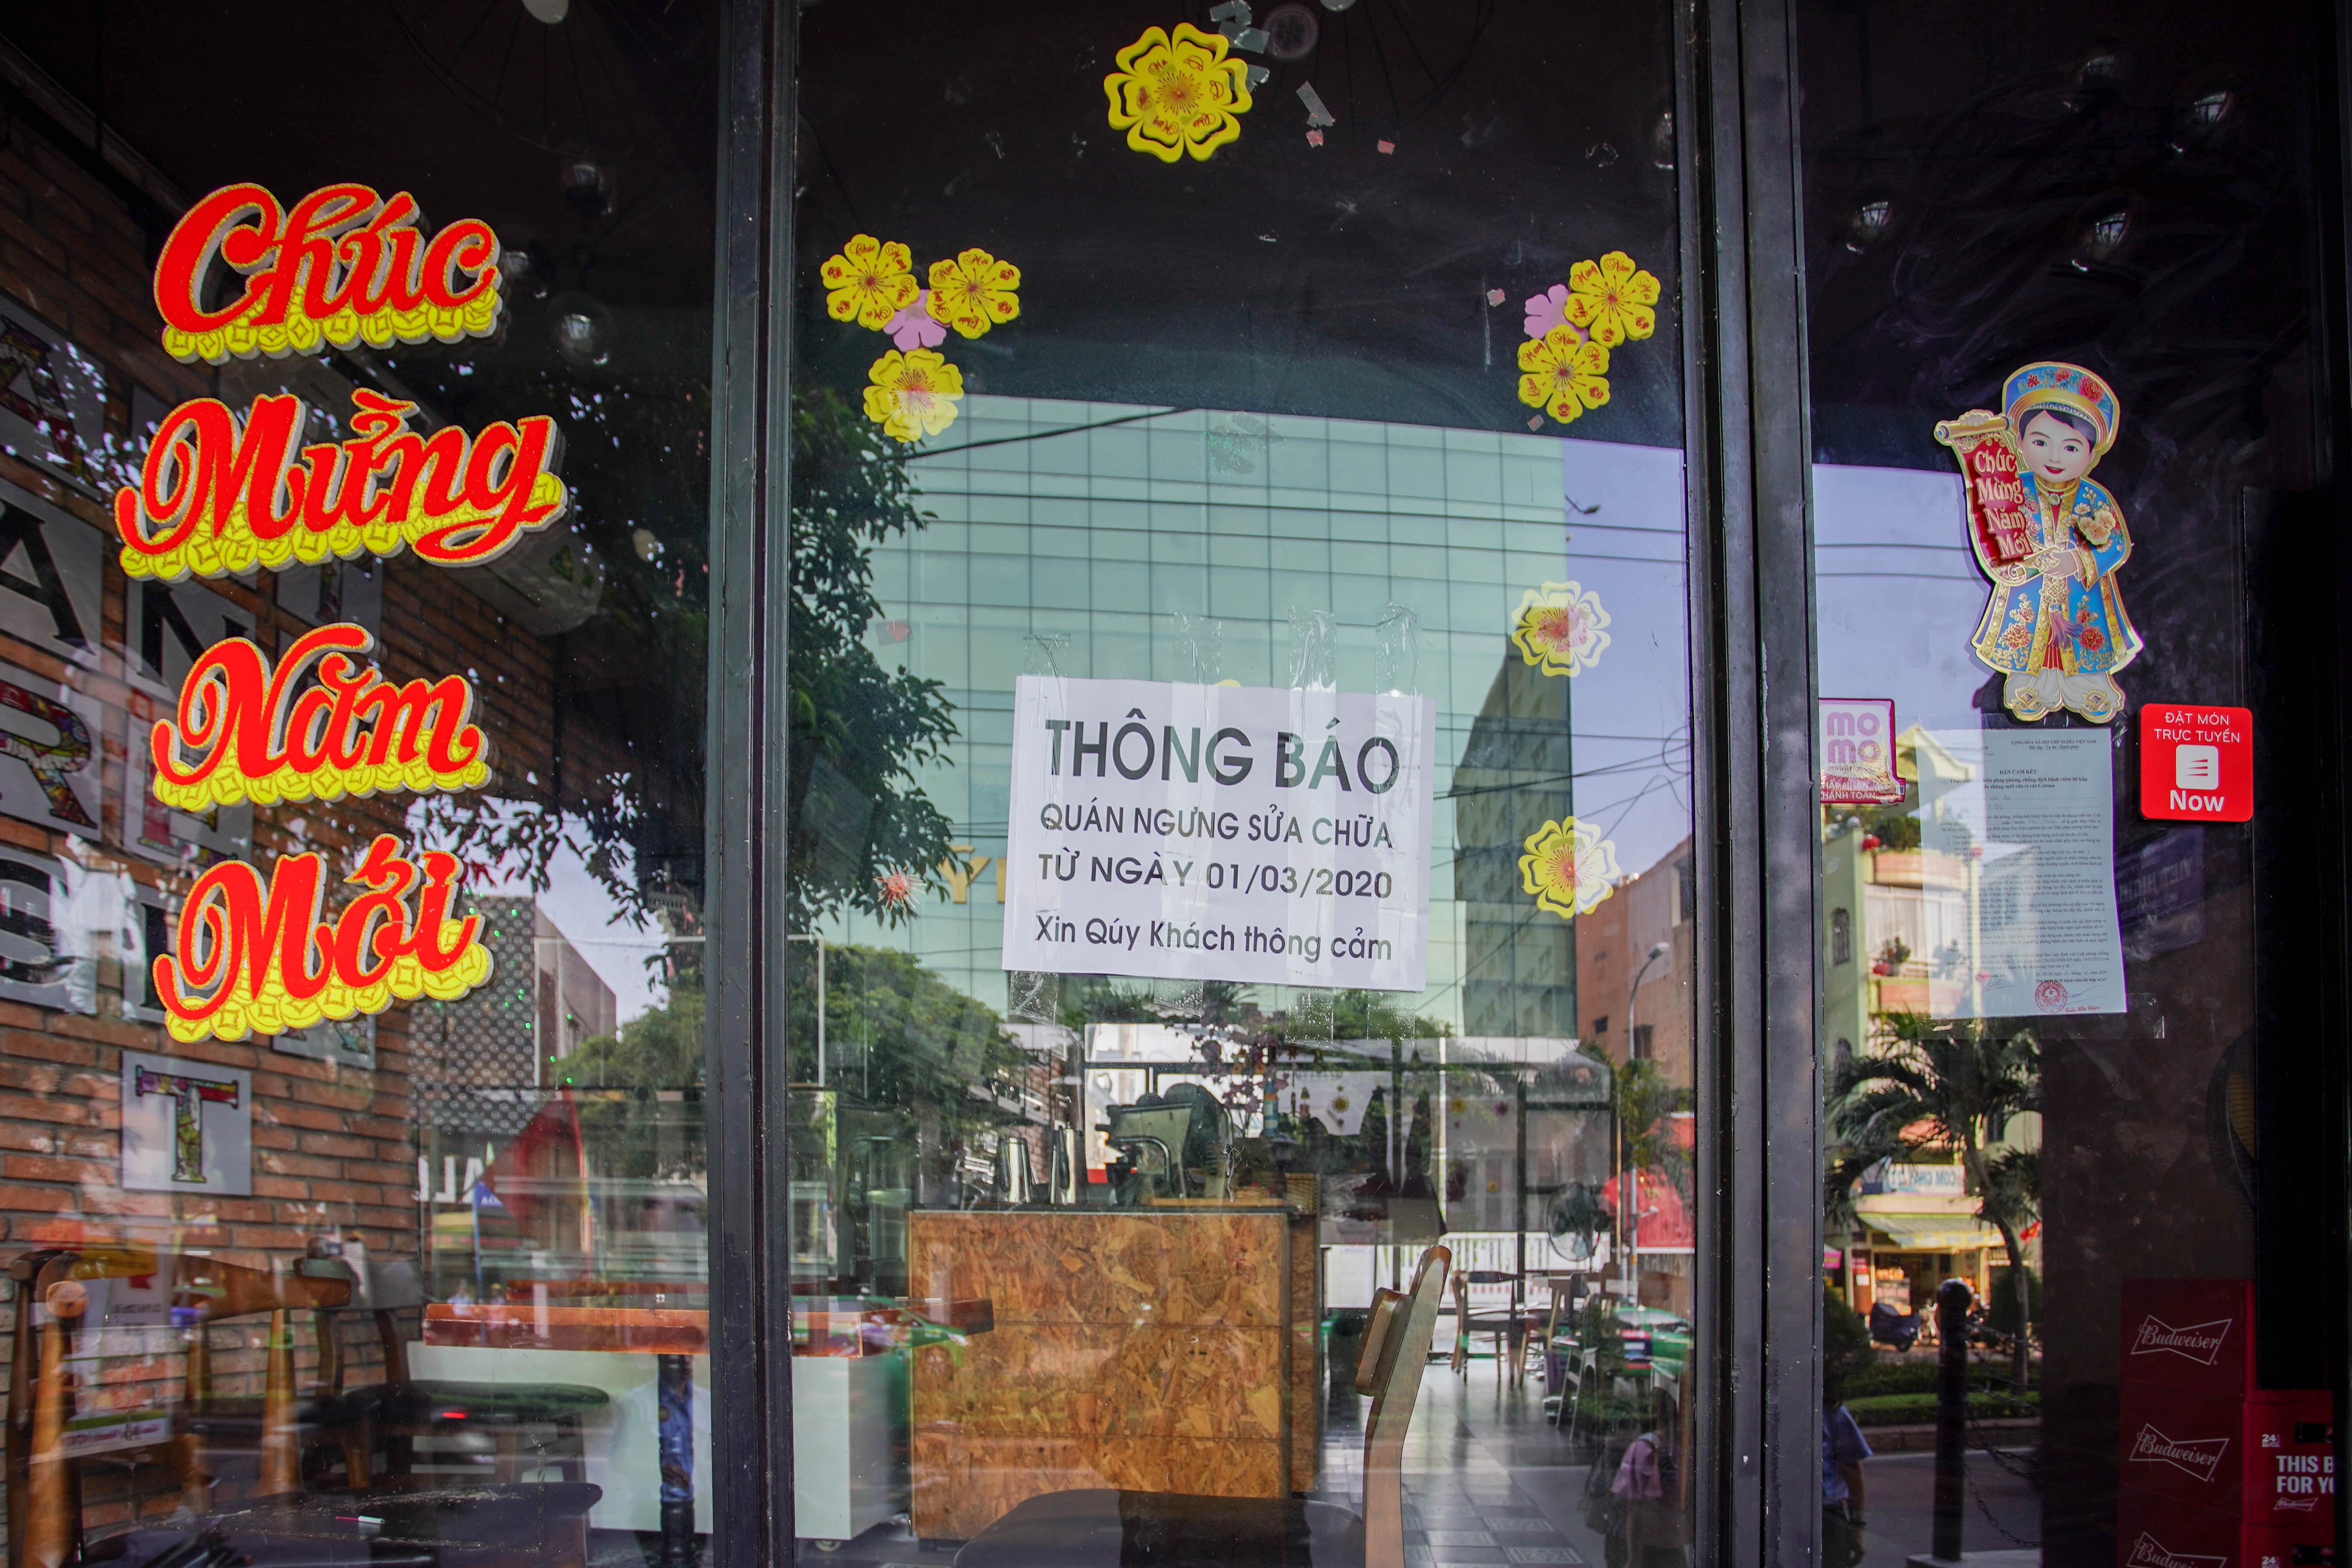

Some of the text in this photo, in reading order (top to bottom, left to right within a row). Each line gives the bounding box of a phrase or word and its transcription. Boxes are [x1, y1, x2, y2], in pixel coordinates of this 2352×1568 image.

[157, 186, 497, 334] Chúc
[116, 388, 557, 561] Mừng
[1974, 448, 2017, 476] Chúc
[1975, 477, 2025, 506] Mừng
[1984, 506, 2026, 533] Năm
[1996, 532, 2034, 560] Mới
[151, 623, 482, 788] Năm
[2165, 710, 2229, 726] ĐẶT MÓN
[2153, 728, 2240, 743] TRỰC TUYẾN
[1045, 707, 1400, 794] THÔNG BÁO
[2170, 789, 2224, 812] Now
[1040, 797, 1393, 849] QUÁN NGƯNG SỬA CHỮA
[1038, 847, 1392, 899] TỪ NGÀY 01/03/2020
[154, 833, 479, 1023] Mới
[1035, 915, 1075, 942] Xin
[1150, 920, 1235, 952] Khách
[1245, 926, 1321, 963] thông
[1331, 927, 1392, 961] cảm
[2138, 1324, 2221, 1350] Budweiser
[2136, 1432, 2216, 1466] Budweiser
[2275, 1455, 2319, 1473] THIS
[2276, 1476, 2314, 1494] FOR
